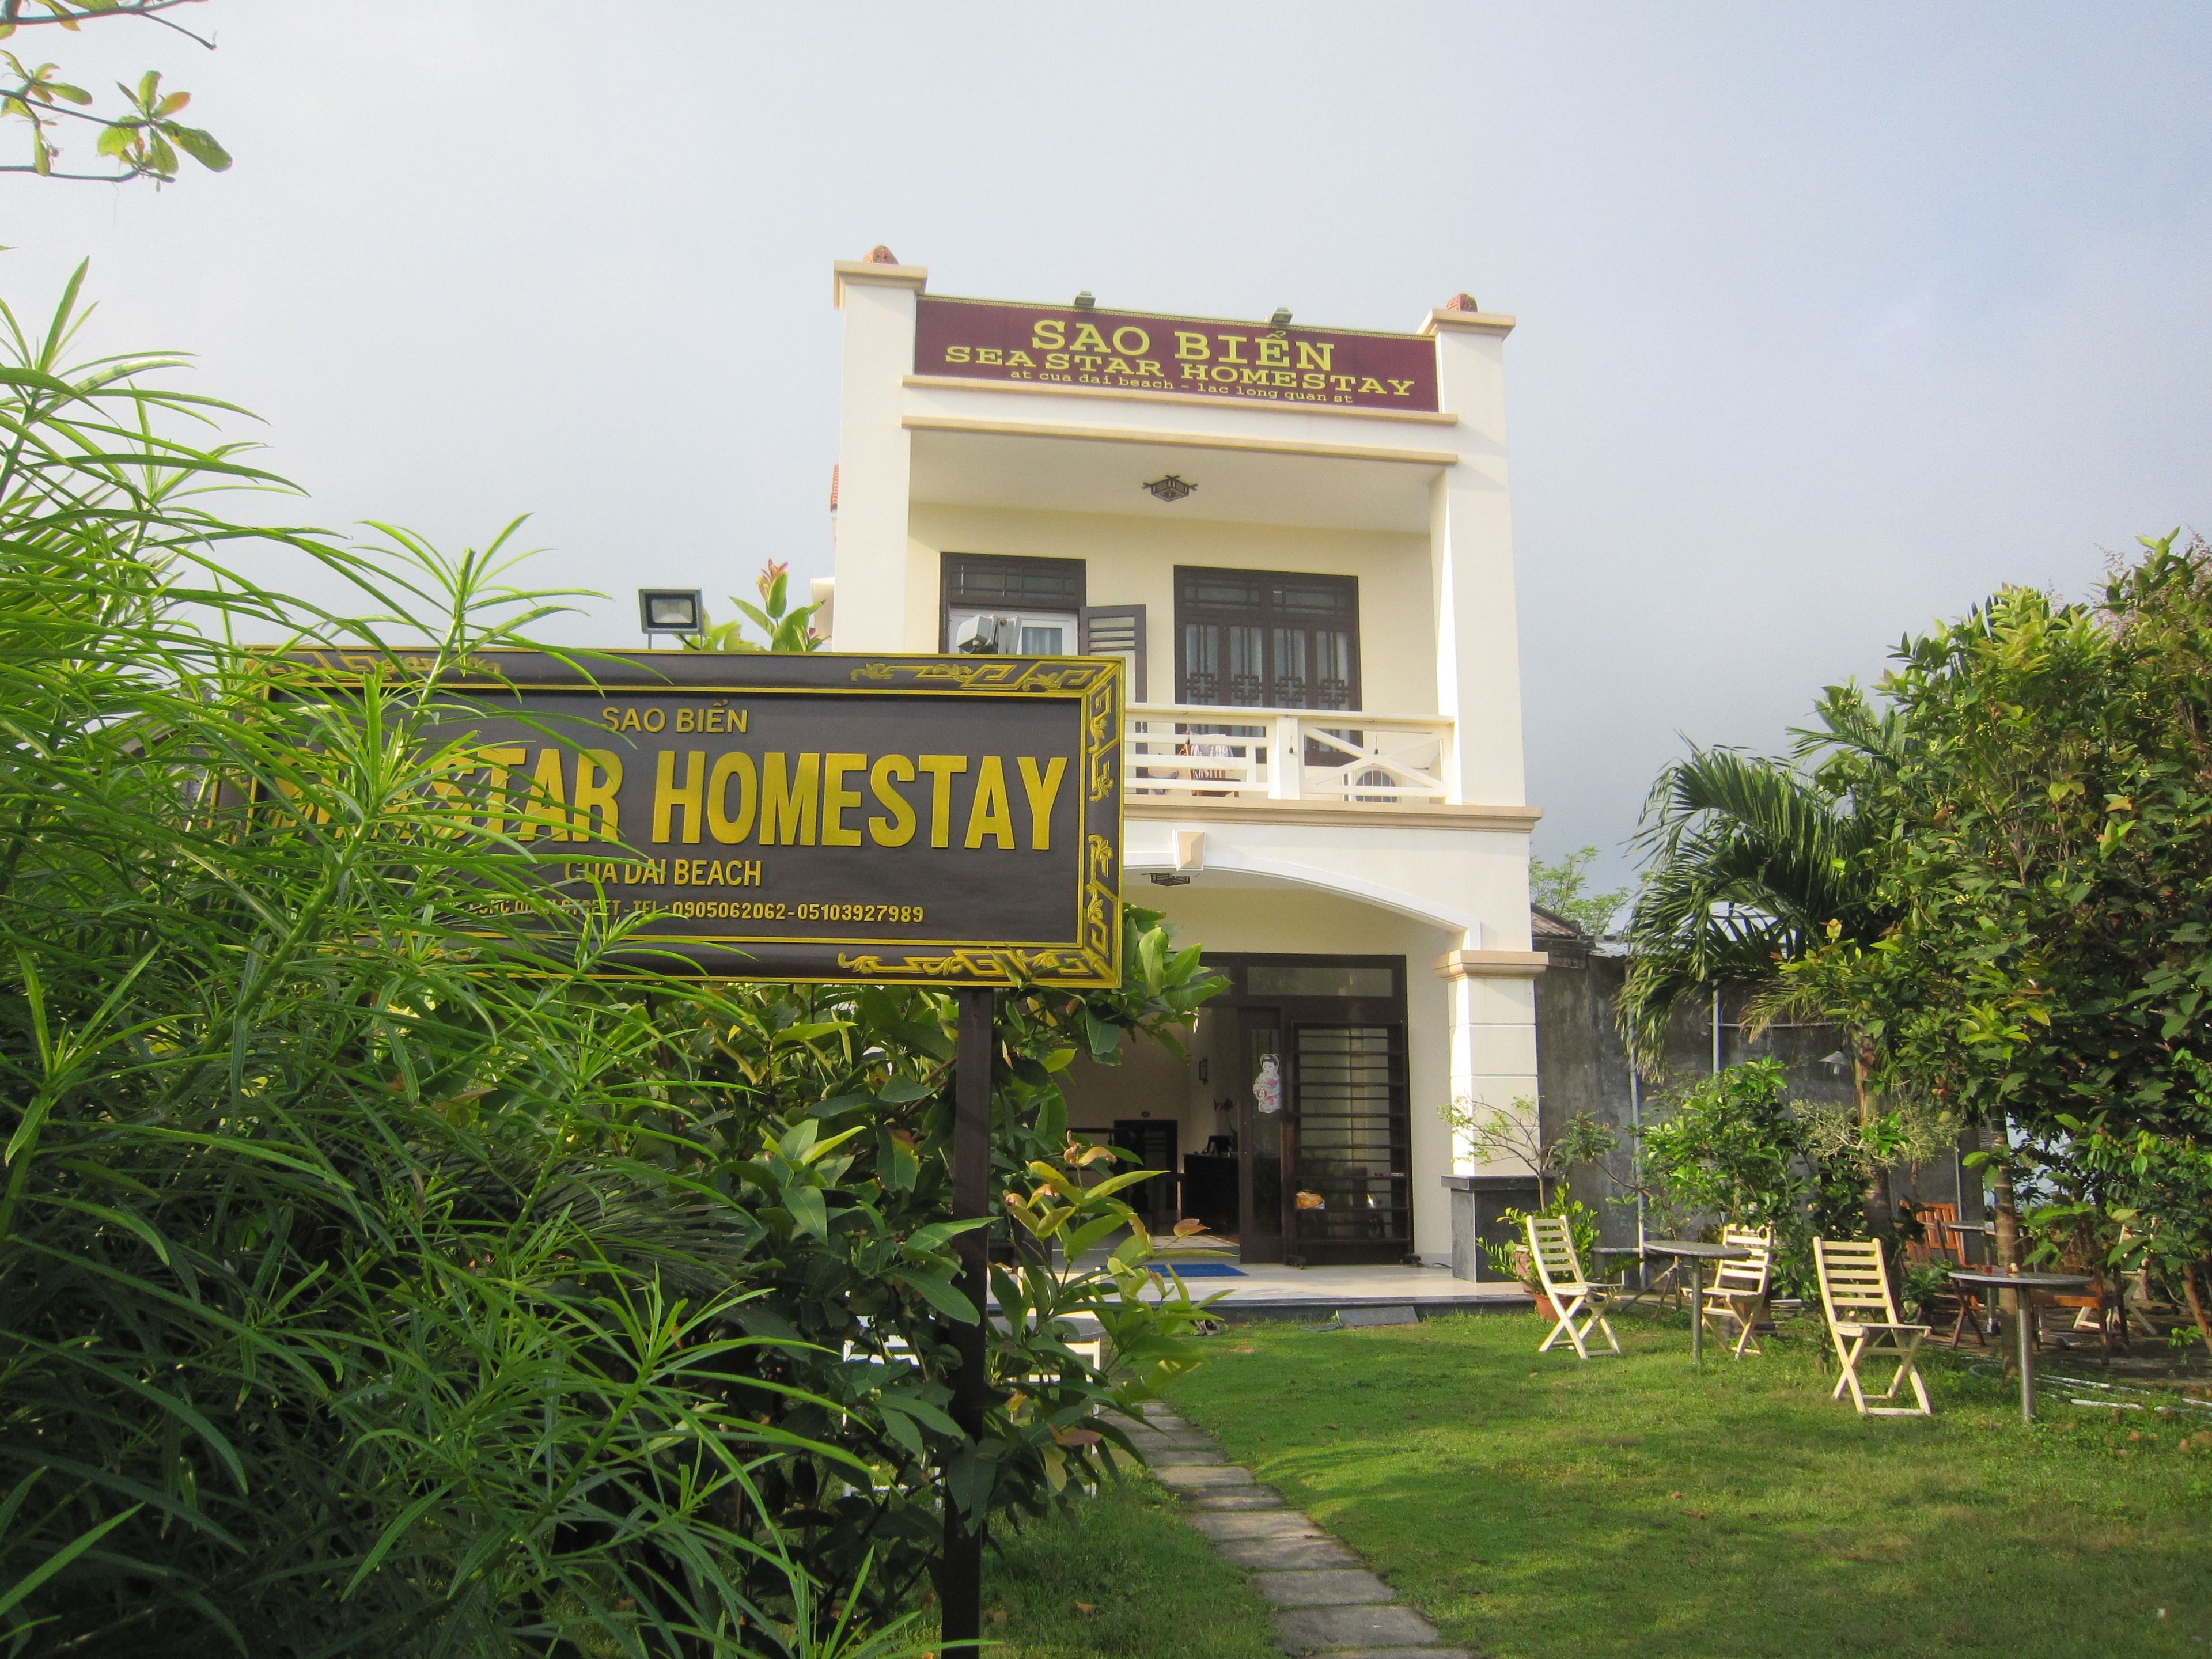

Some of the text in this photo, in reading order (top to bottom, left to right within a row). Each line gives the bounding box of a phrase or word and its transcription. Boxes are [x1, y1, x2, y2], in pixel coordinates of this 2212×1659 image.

[1032, 320, 1334, 371] SAO BIỂN
[945, 346, 1415, 396] SEA STAR HOMESTAY
[1010, 370, 1032, 380] at
[1039, 373, 1072, 382] cua
[1079, 373, 1111, 384] dai
[1118, 376, 1175, 389] beach
[1198, 382, 1229, 393] lac
[1236, 385, 1279, 399] long
[1284, 392, 1327, 402] quan
[1334, 394, 1353, 403] st
[601, 707, 666, 733] SAO
[431, 748, 624, 843] STAR
[652, 751, 1067, 851] HOMESTAY
[674, 859, 763, 887] BEACH
